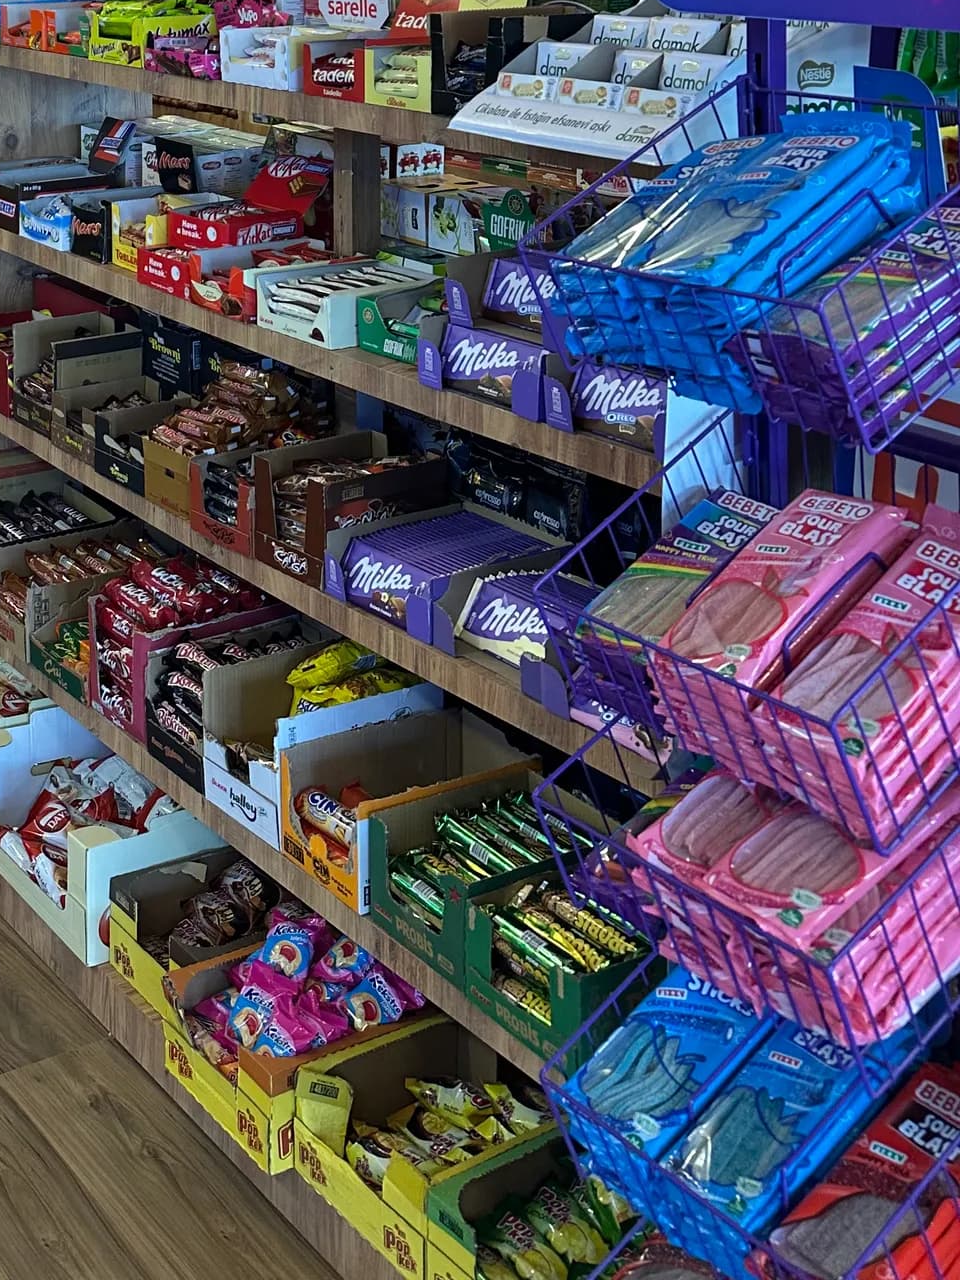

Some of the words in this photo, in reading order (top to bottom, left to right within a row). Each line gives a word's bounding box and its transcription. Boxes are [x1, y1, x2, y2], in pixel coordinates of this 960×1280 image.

[396, 11, 428, 30] tad
[652, 27, 700, 53] damak
[786, 136, 857, 149] BEBETO
[159, 151, 191, 171] Mars
[72, 216, 102, 237] Mars
[182, 219, 199, 232] Have
[239, 221, 273, 246] KitKat
[115, 248, 138, 267] TOBLER
[148, 257, 164, 269] Have
[447, 338, 521, 376] Milka
[581, 373, 663, 412] Milka
[606, 412, 636, 425] OREO
[719, 493, 775, 520] BEBET
[802, 498, 872, 519] BEBETO
[697, 520, 749, 548] BLAS
[715, 515, 758, 536] SOUR
[779, 521, 842, 546] BLAST
[797, 514, 843, 533] SOUR
[920, 543, 960, 573] BEB
[348, 555, 414, 592] Milka
[916, 567, 957, 591] SOU
[230, 786, 257, 822] halley
[919, 1084, 960, 1118] BEB
[919, 1114, 960, 1140] SOU
